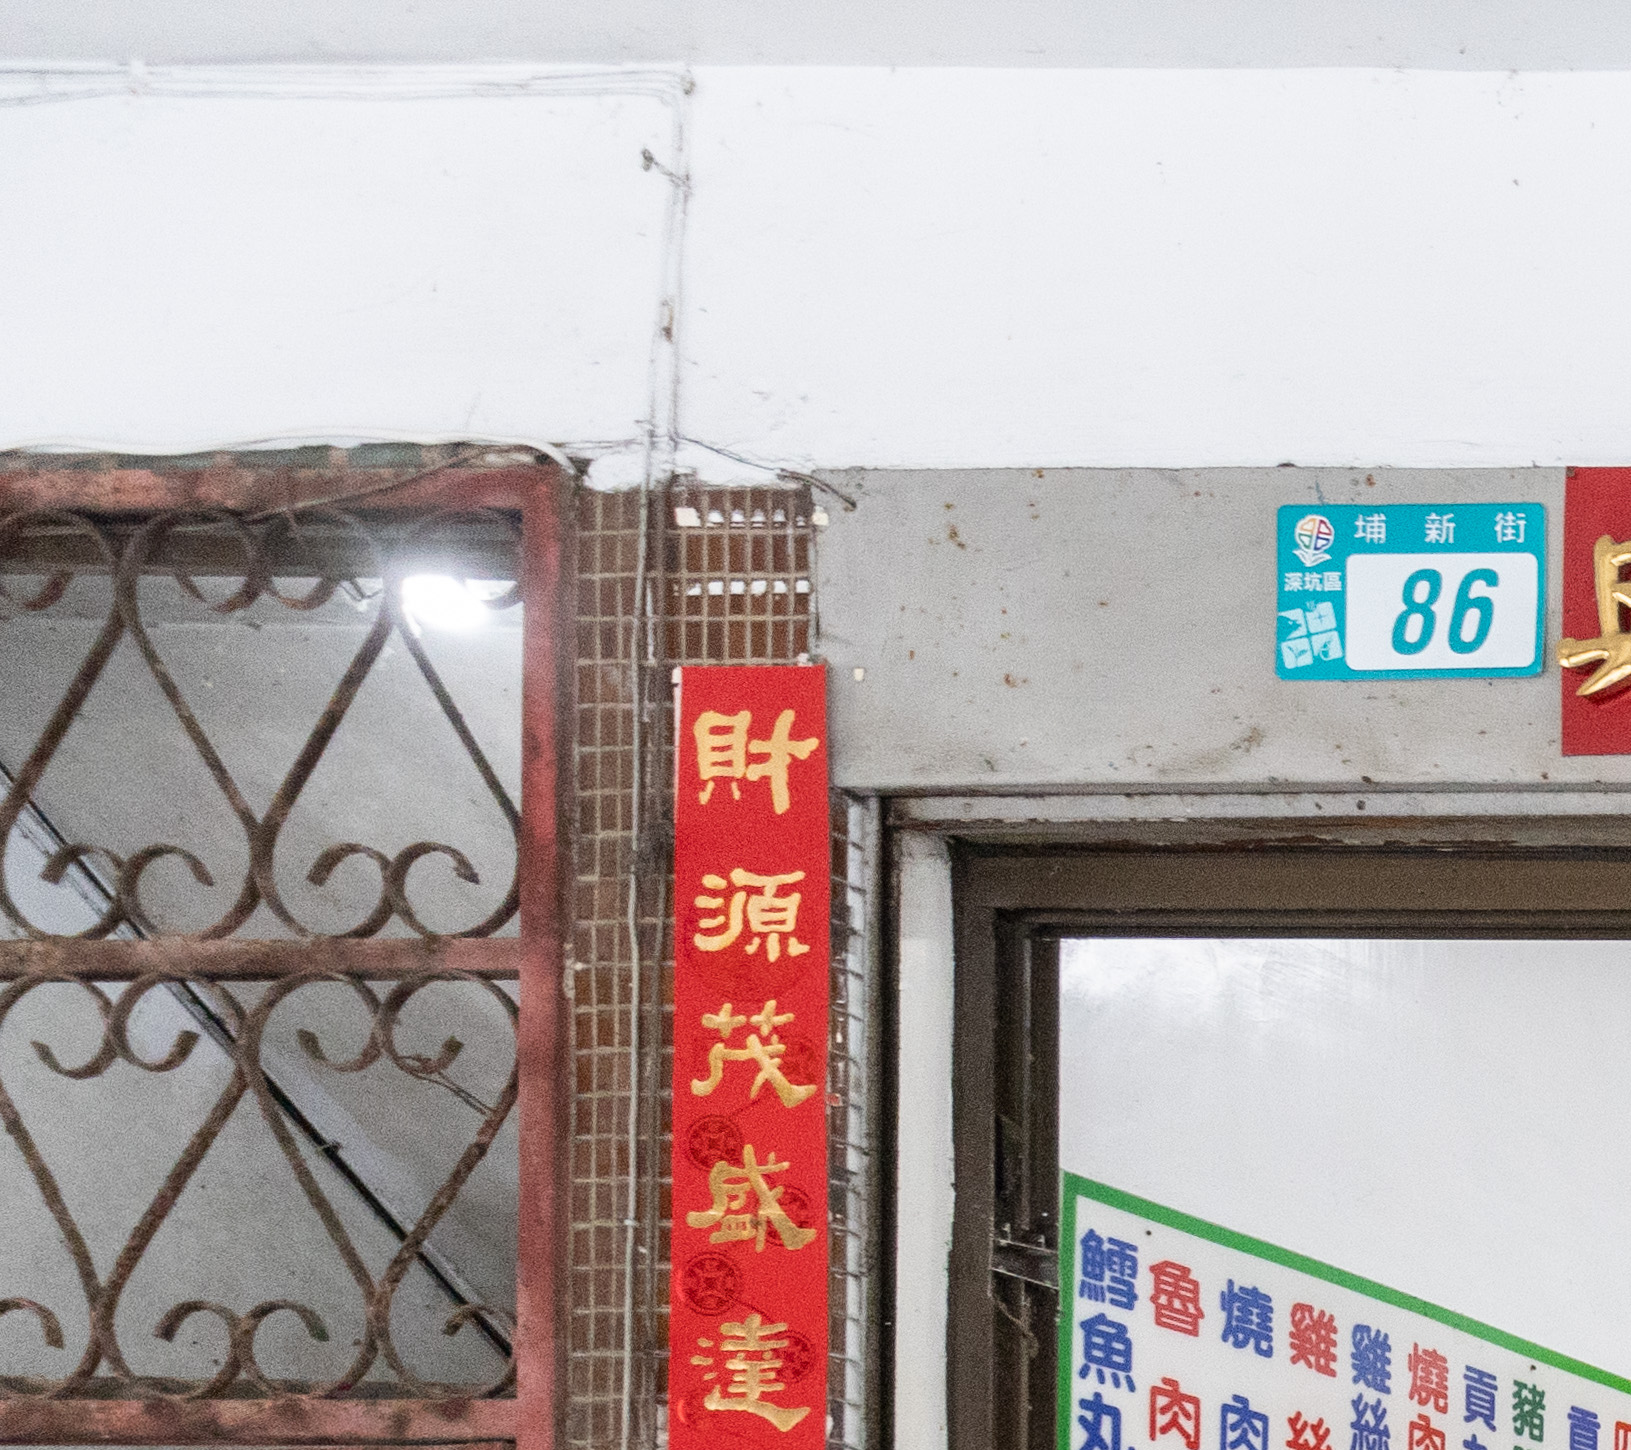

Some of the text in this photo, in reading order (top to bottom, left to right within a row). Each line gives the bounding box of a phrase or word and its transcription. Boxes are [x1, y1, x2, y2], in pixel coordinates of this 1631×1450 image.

[1353, 511, 1528, 546] 埔新街
[1283, 571, 1343, 594] 深坑區
[1390, 567, 1500, 656] 86
